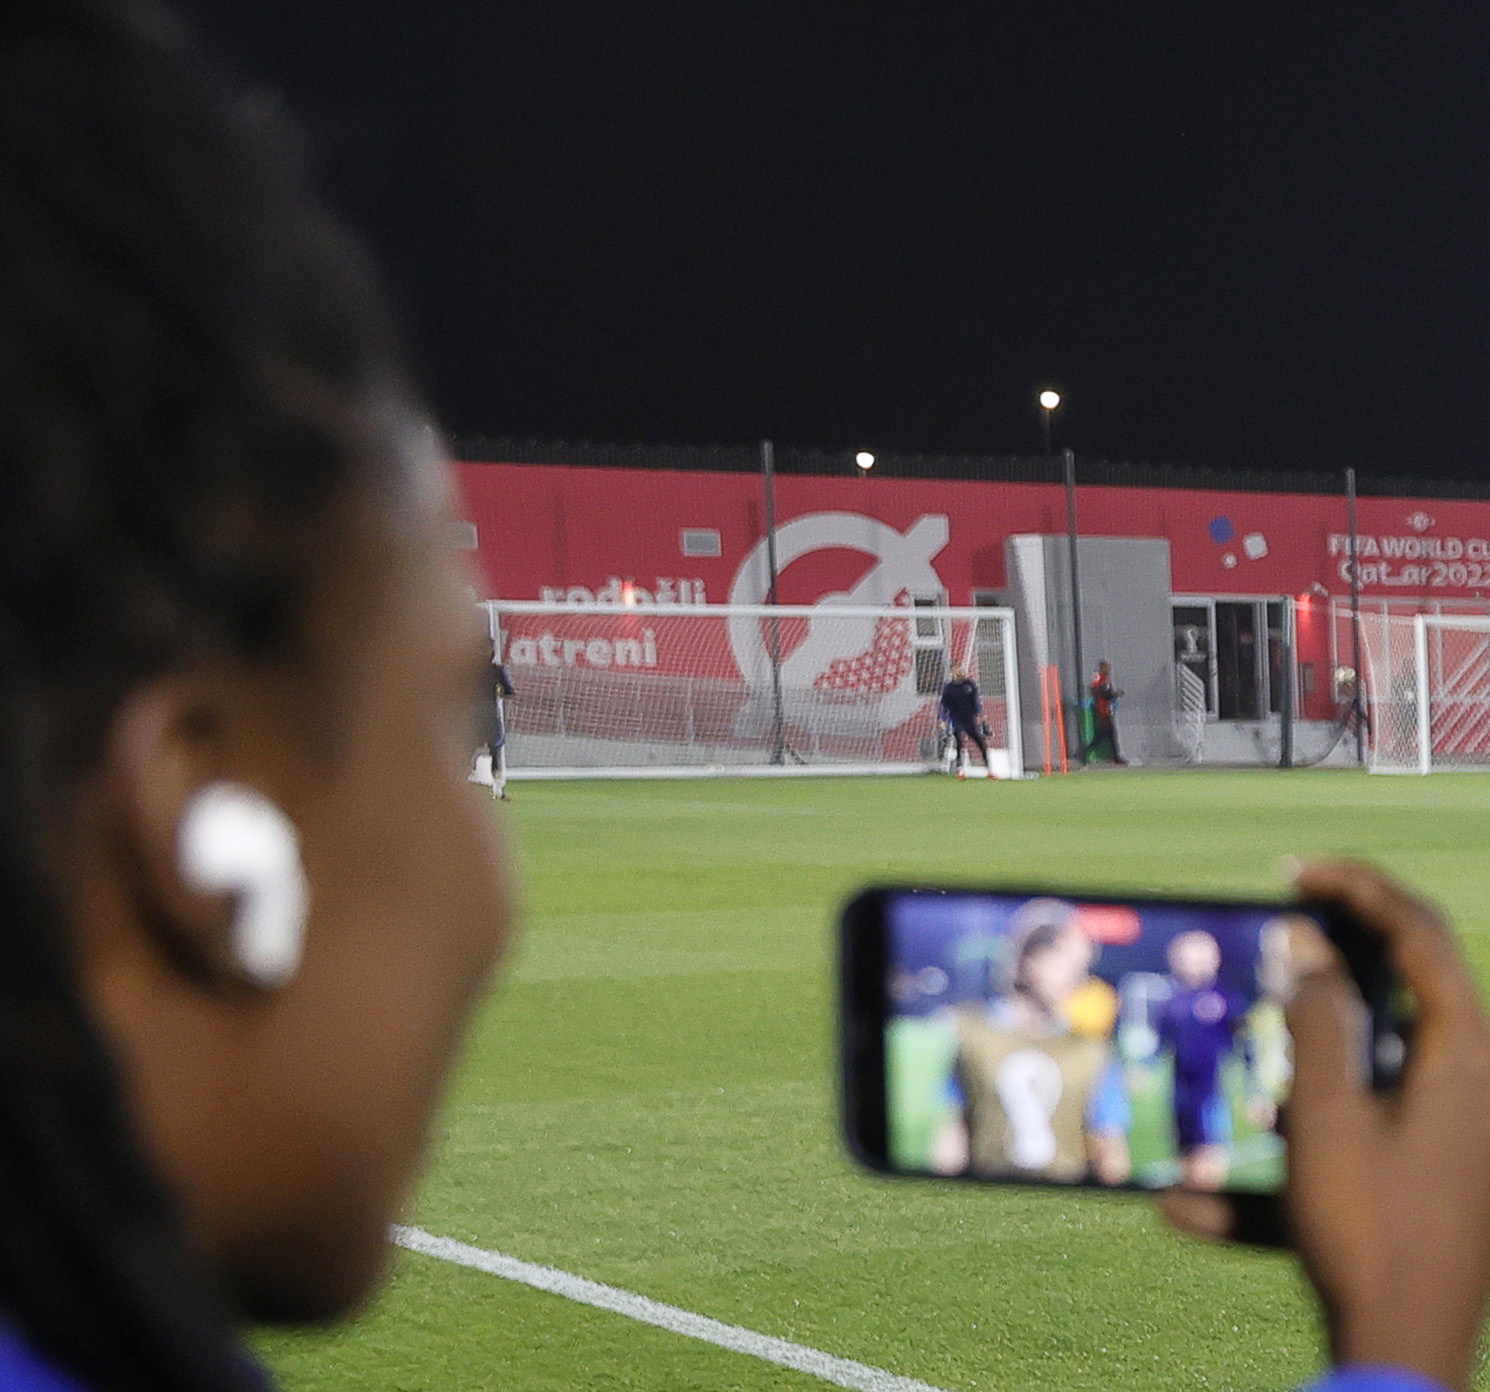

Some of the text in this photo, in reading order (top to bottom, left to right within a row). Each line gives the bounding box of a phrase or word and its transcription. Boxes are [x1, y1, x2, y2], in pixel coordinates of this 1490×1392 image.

[1328, 533, 1379, 557] FIFA
[1380, 535, 1463, 560] WORLD
[500, 628, 658, 667] atreni
